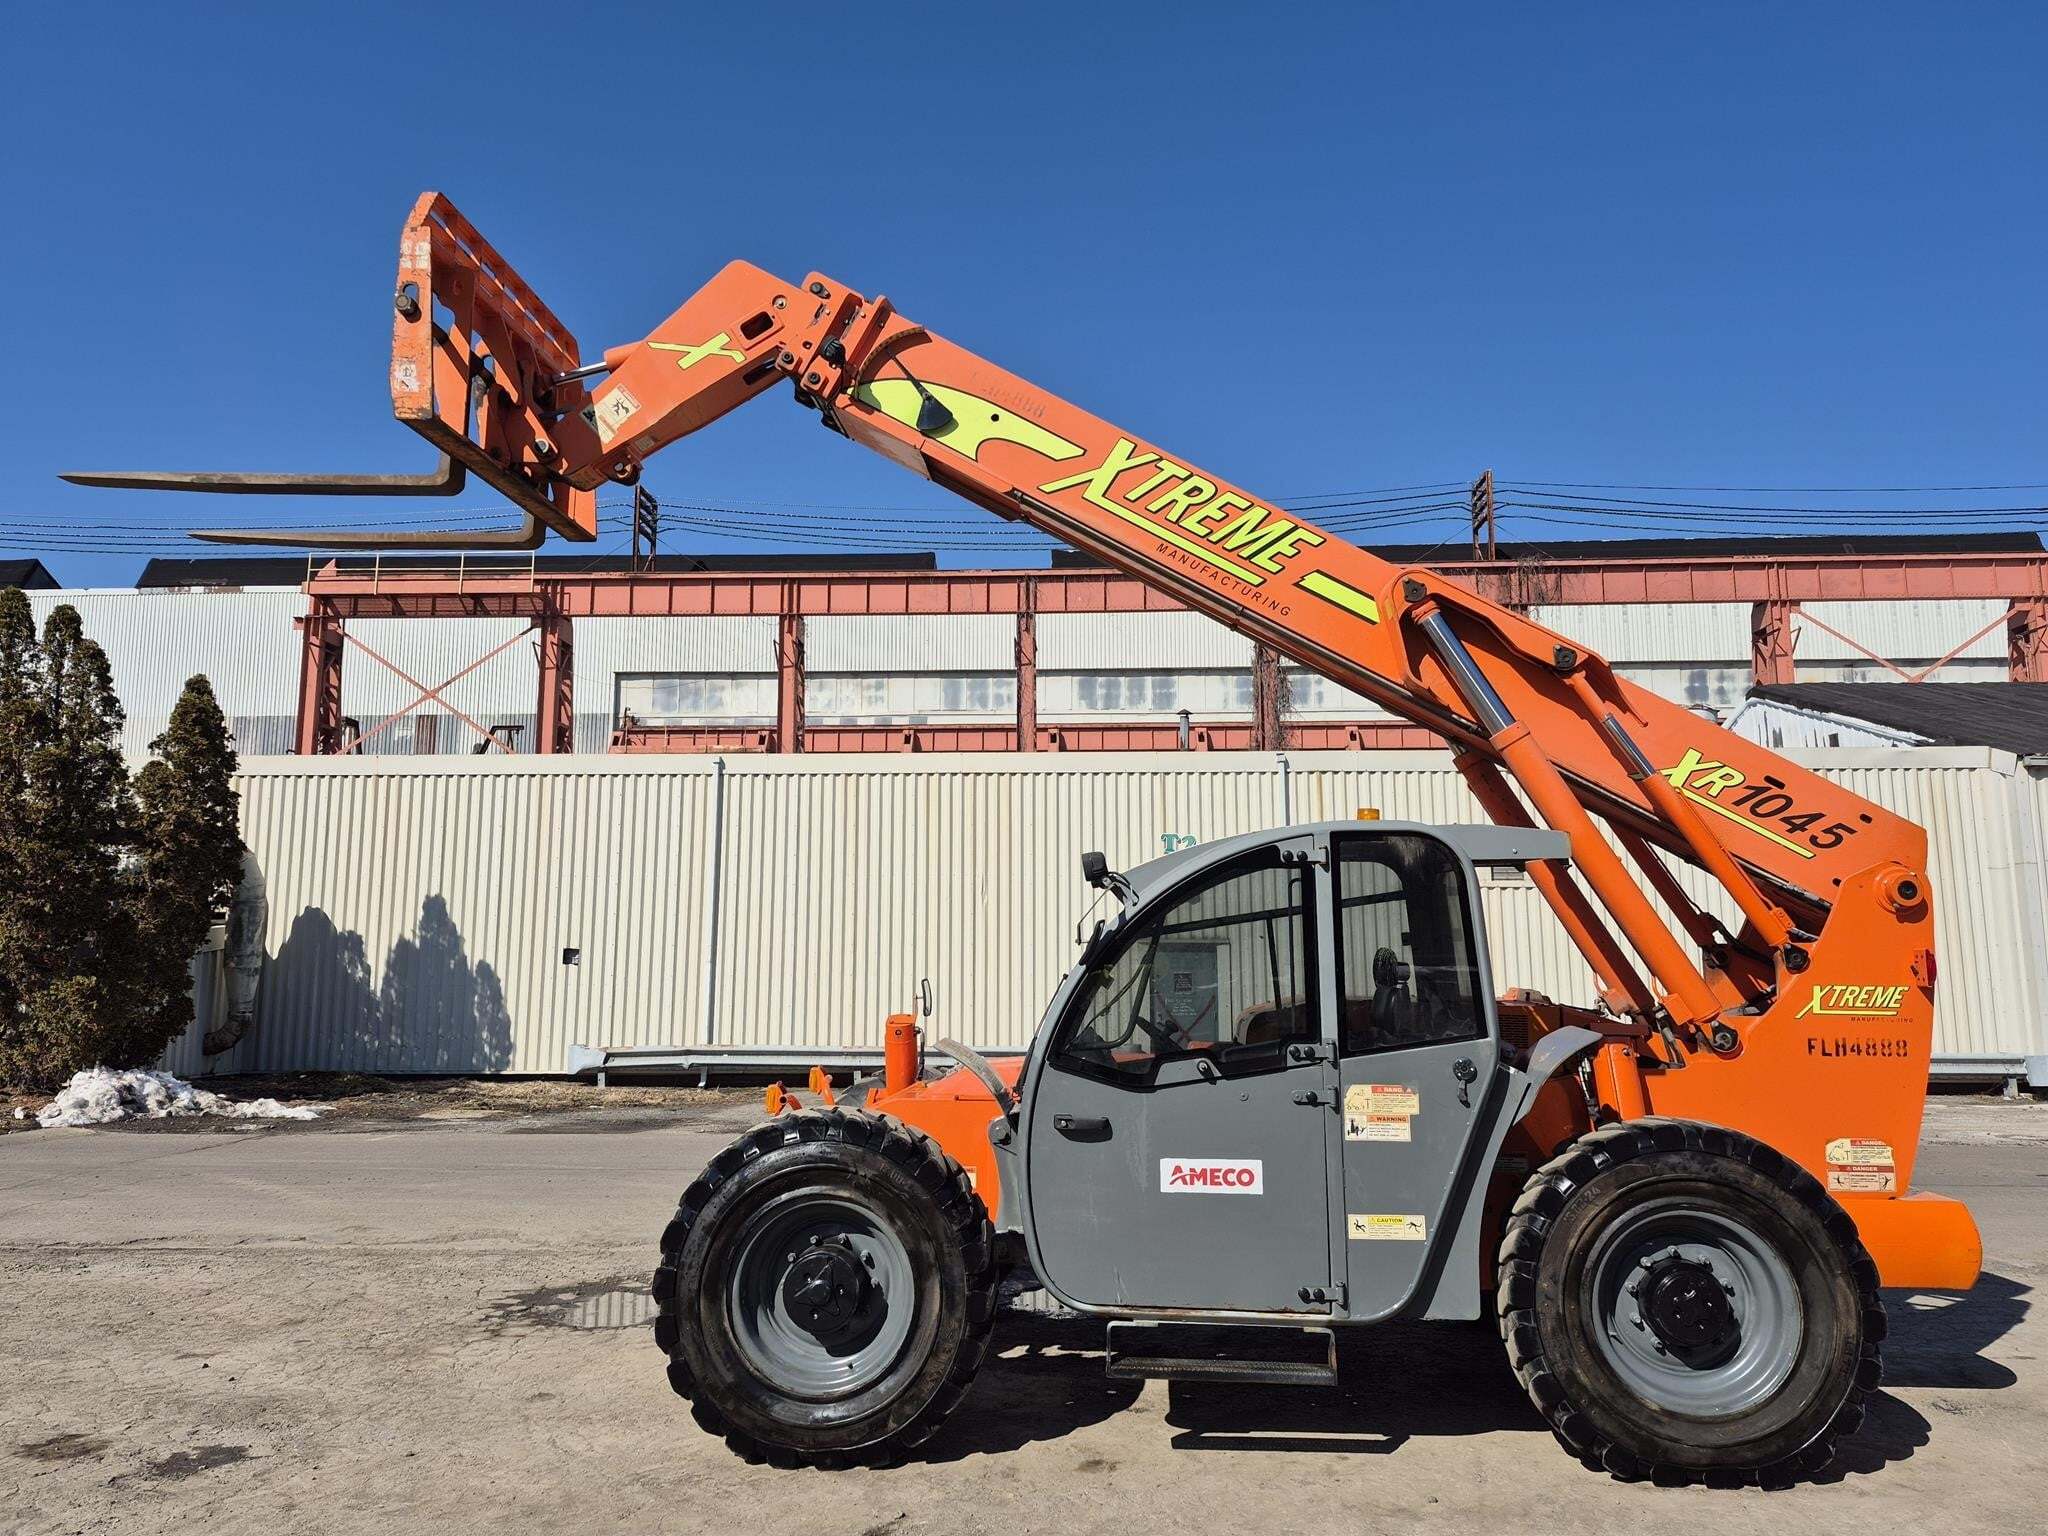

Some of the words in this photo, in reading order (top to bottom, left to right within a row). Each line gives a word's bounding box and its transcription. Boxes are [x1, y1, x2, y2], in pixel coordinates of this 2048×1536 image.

[1037, 436, 1325, 580] XTREME
[1155, 543, 1292, 618] MANUFACTURING
[1795, 984, 1910, 1020] XTREME
[1169, 1165, 1255, 1187] AMECO
